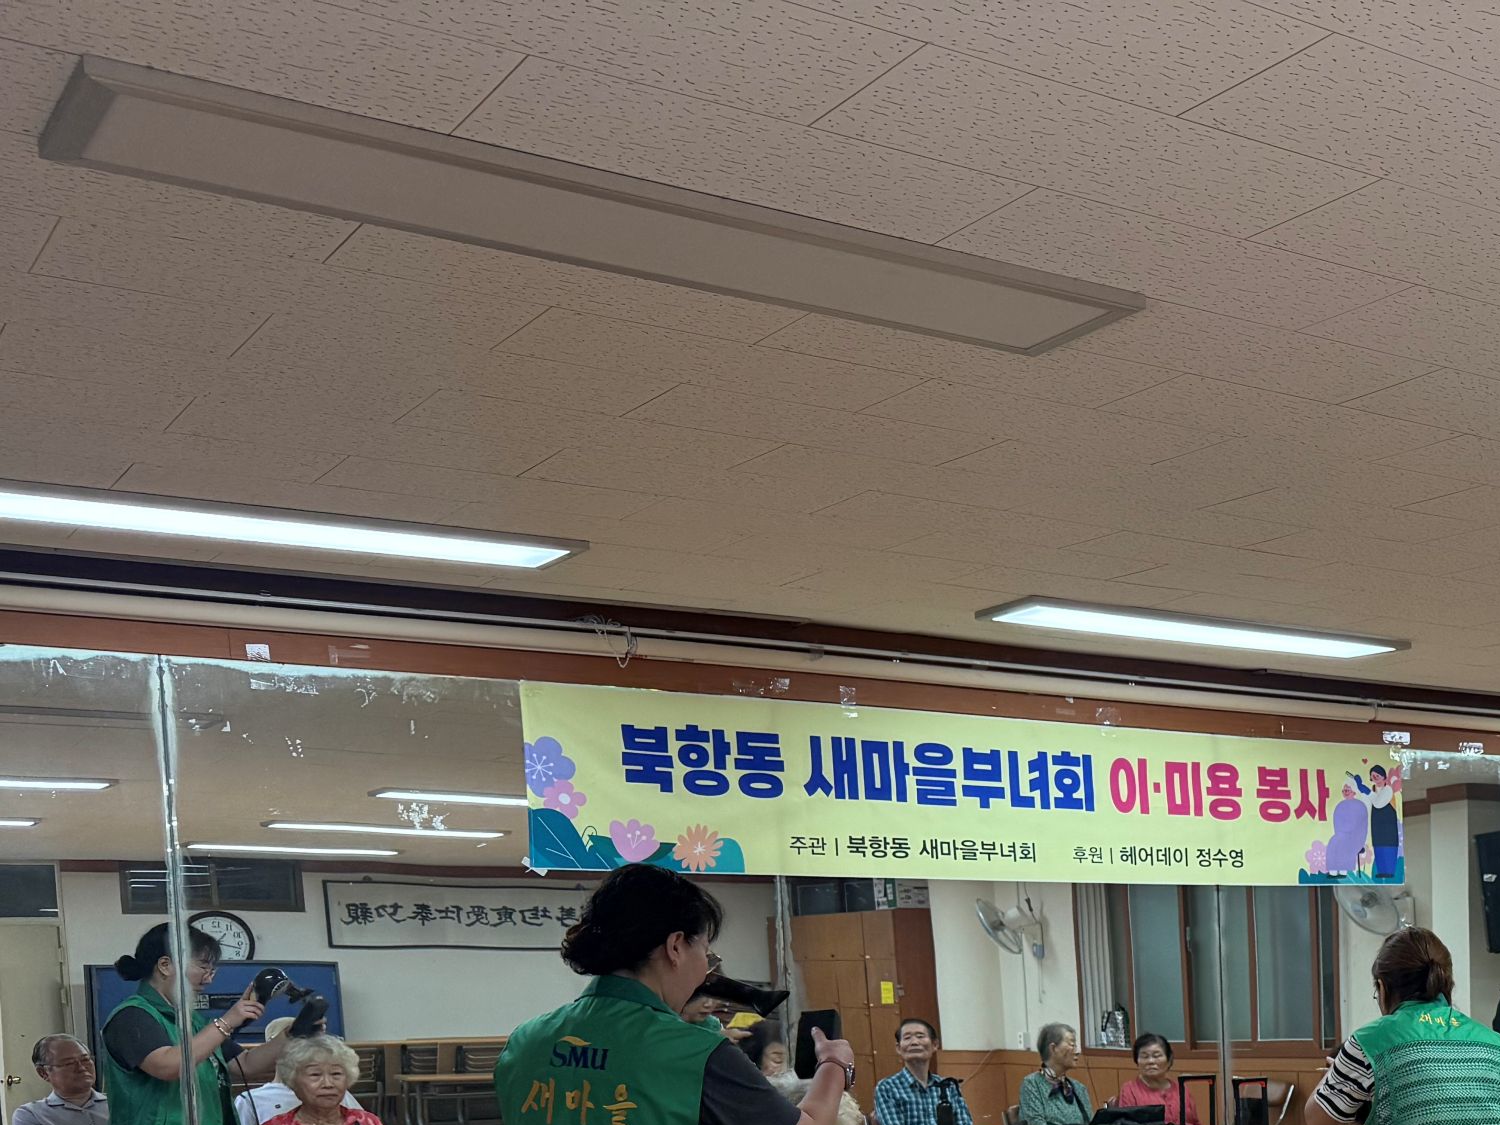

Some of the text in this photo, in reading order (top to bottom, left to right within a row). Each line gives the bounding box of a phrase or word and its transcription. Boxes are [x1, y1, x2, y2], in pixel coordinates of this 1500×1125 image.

[620, 723, 1329, 822] 북항동 새마을부녀회 이·미용 봉사
[790, 836, 1036, 863] 주관 북항동 새마을부녀회
[1073, 846, 1245, 868] 후원 헤어데이 정수영
[550, 1043, 609, 1071] SMU
